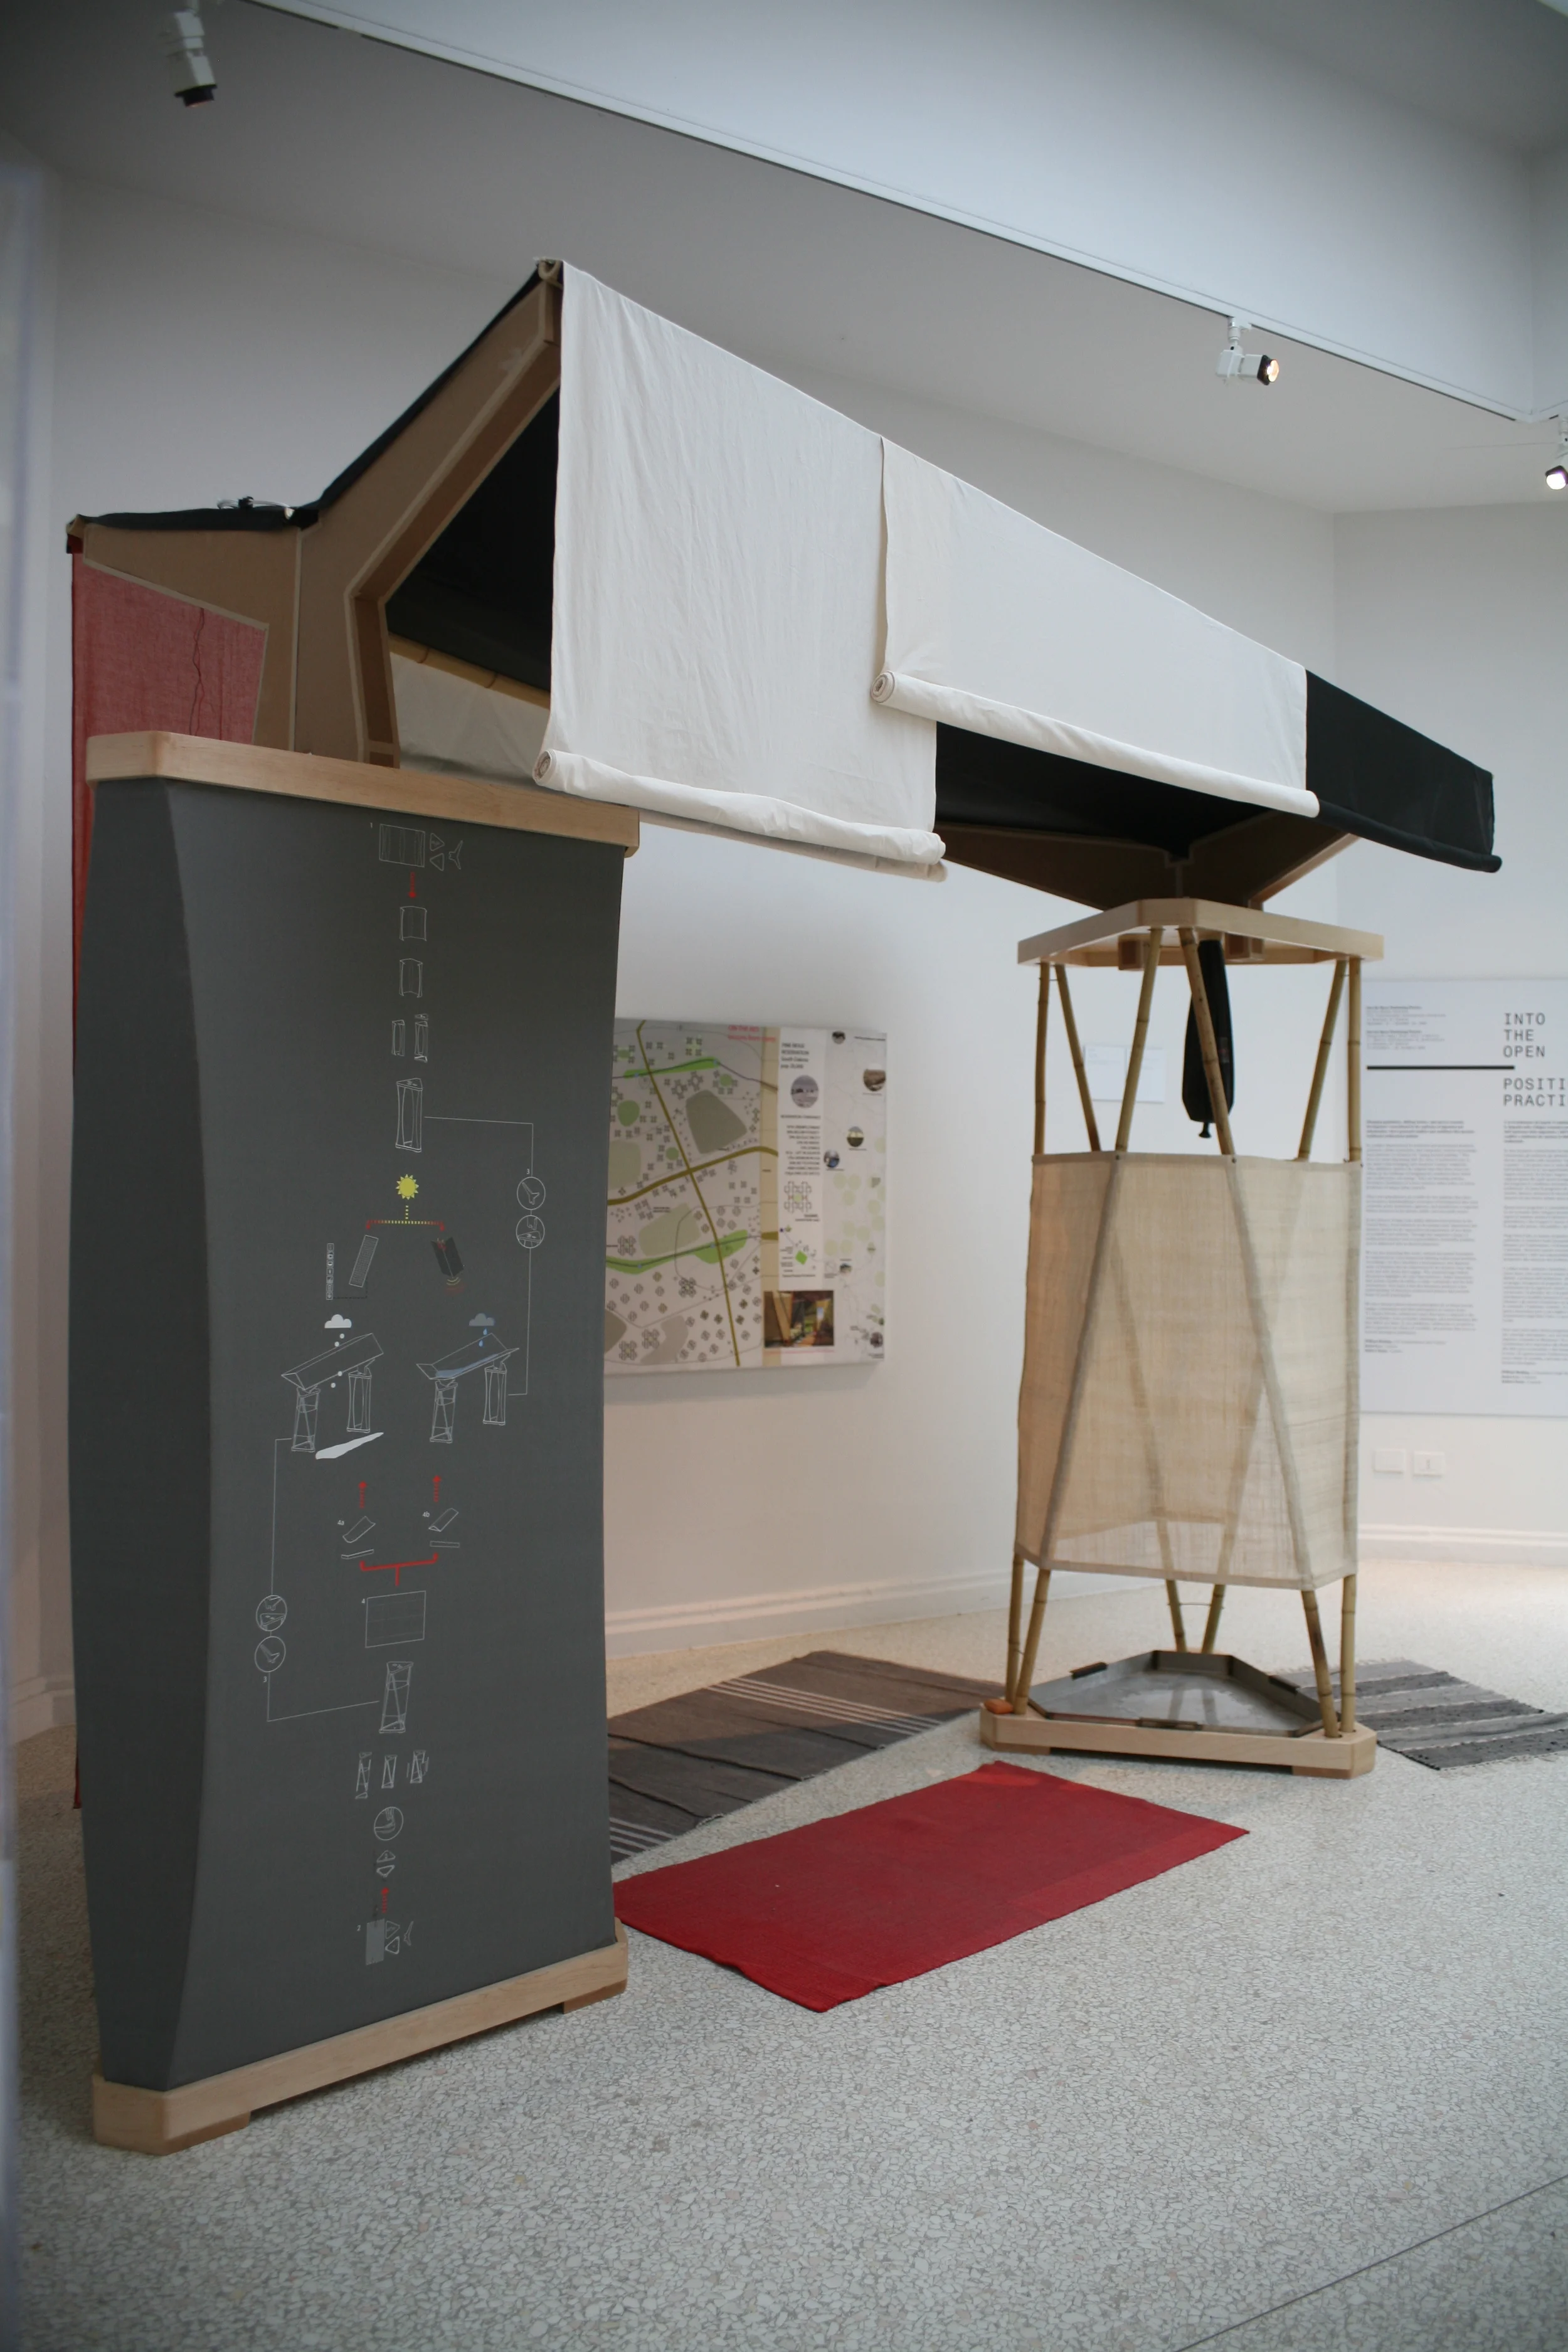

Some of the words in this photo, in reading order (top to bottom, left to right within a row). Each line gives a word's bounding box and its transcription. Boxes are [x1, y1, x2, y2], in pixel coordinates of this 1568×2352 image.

[1504, 1012, 1545, 1025] INTO
[1503, 1029, 1534, 1041] THE
[1503, 1045, 1545, 1057] OPEN
[1503, 1078, 1568, 1090] POSITI
[1503, 1094, 1568, 1107] PRACTI
